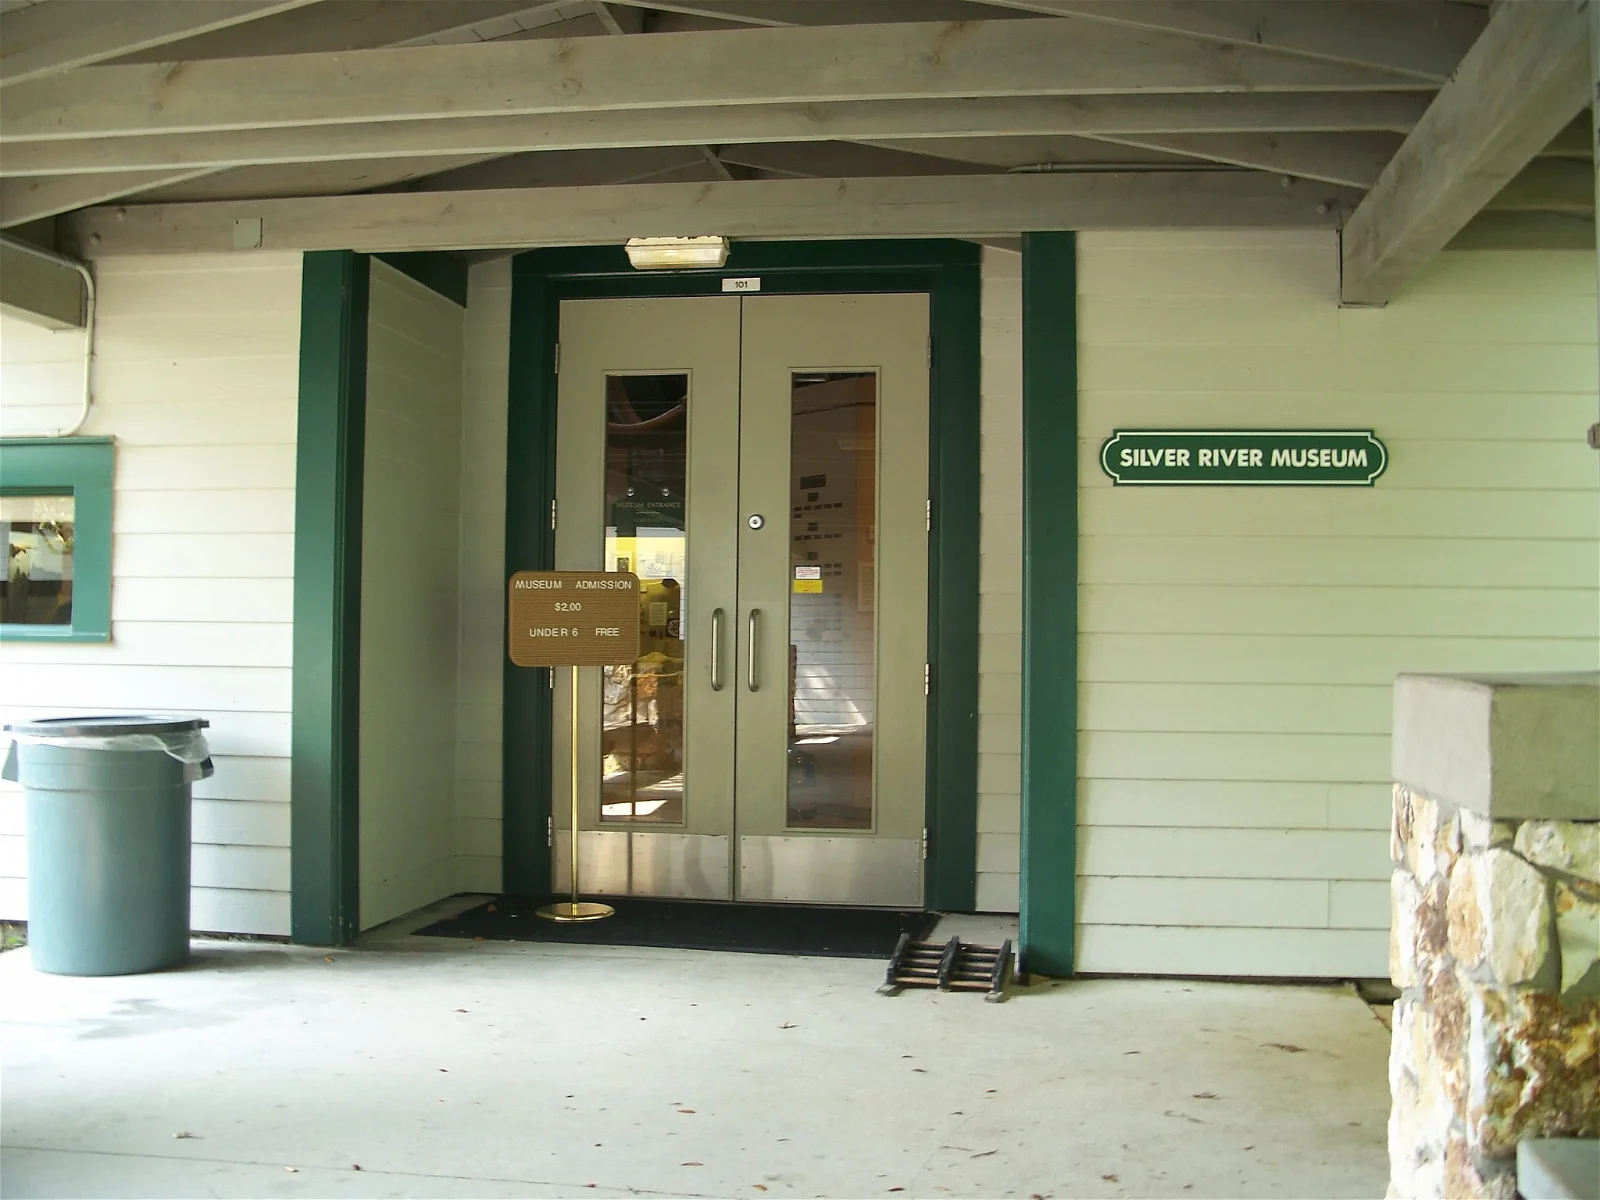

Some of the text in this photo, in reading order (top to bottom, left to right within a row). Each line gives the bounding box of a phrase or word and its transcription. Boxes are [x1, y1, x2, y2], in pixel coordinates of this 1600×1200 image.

[1120, 448, 1368, 467] SILVER RIVER MUSEUM
[515, 580, 632, 589] MUSEUM ADMISSION
[554, 602, 582, 612] $2.00
[529, 627, 620, 637] UNDER 6 FREE
